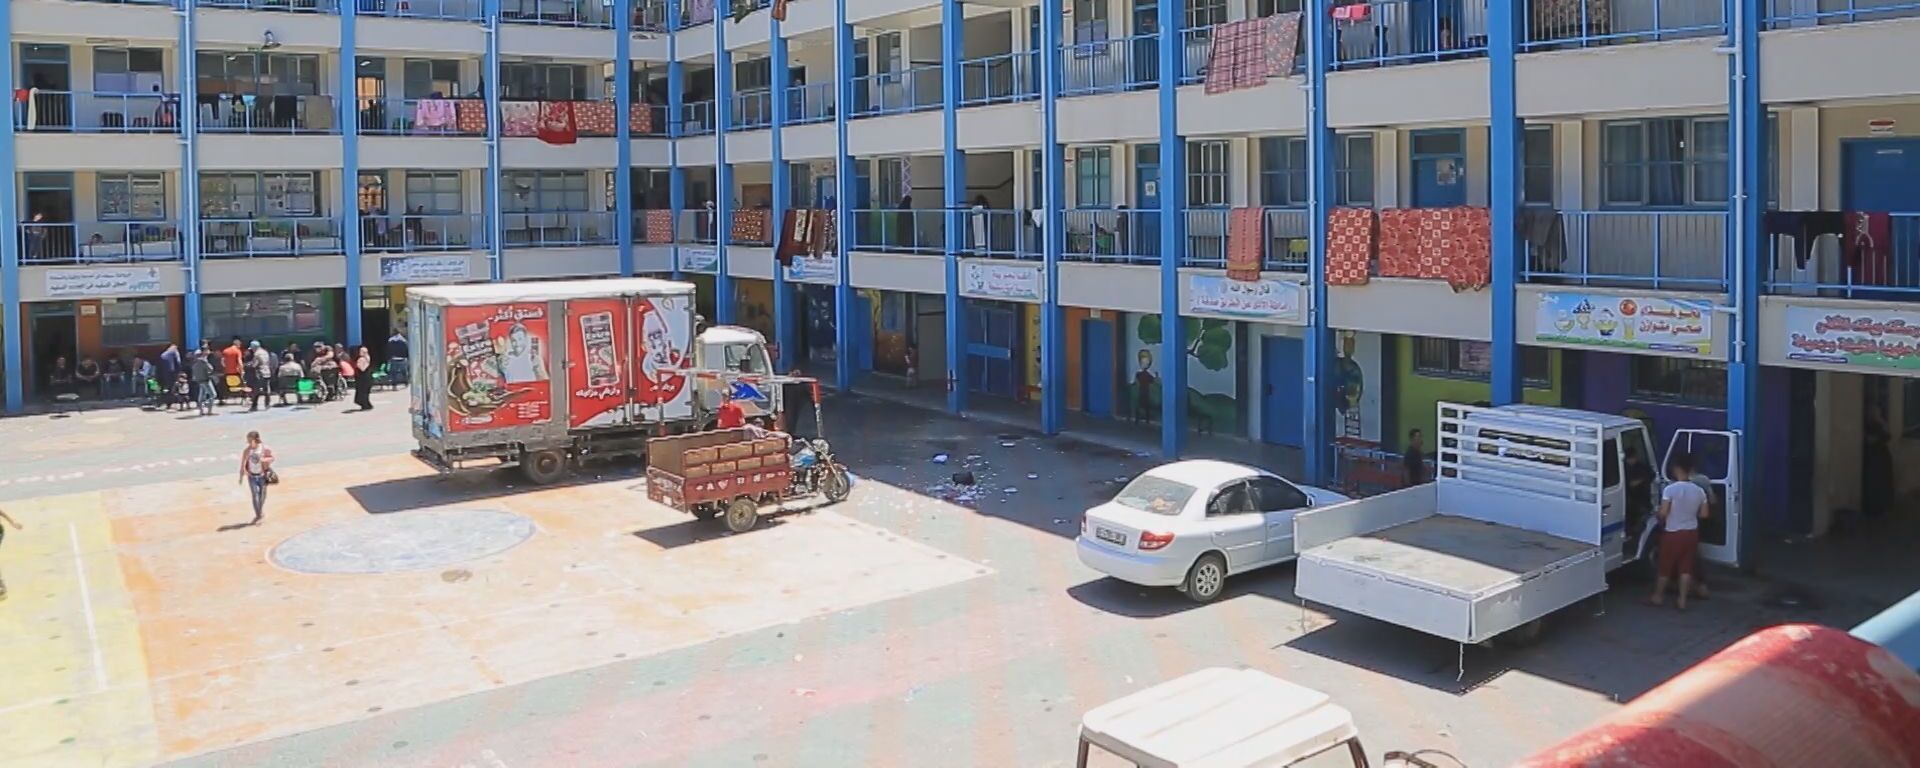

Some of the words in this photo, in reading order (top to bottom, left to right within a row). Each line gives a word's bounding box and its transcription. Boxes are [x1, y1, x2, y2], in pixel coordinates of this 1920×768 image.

[1679, 307, 1701, 320] نحو
[1639, 320, 1670, 332] متوازن
[1671, 324, 1703, 335] صحي
